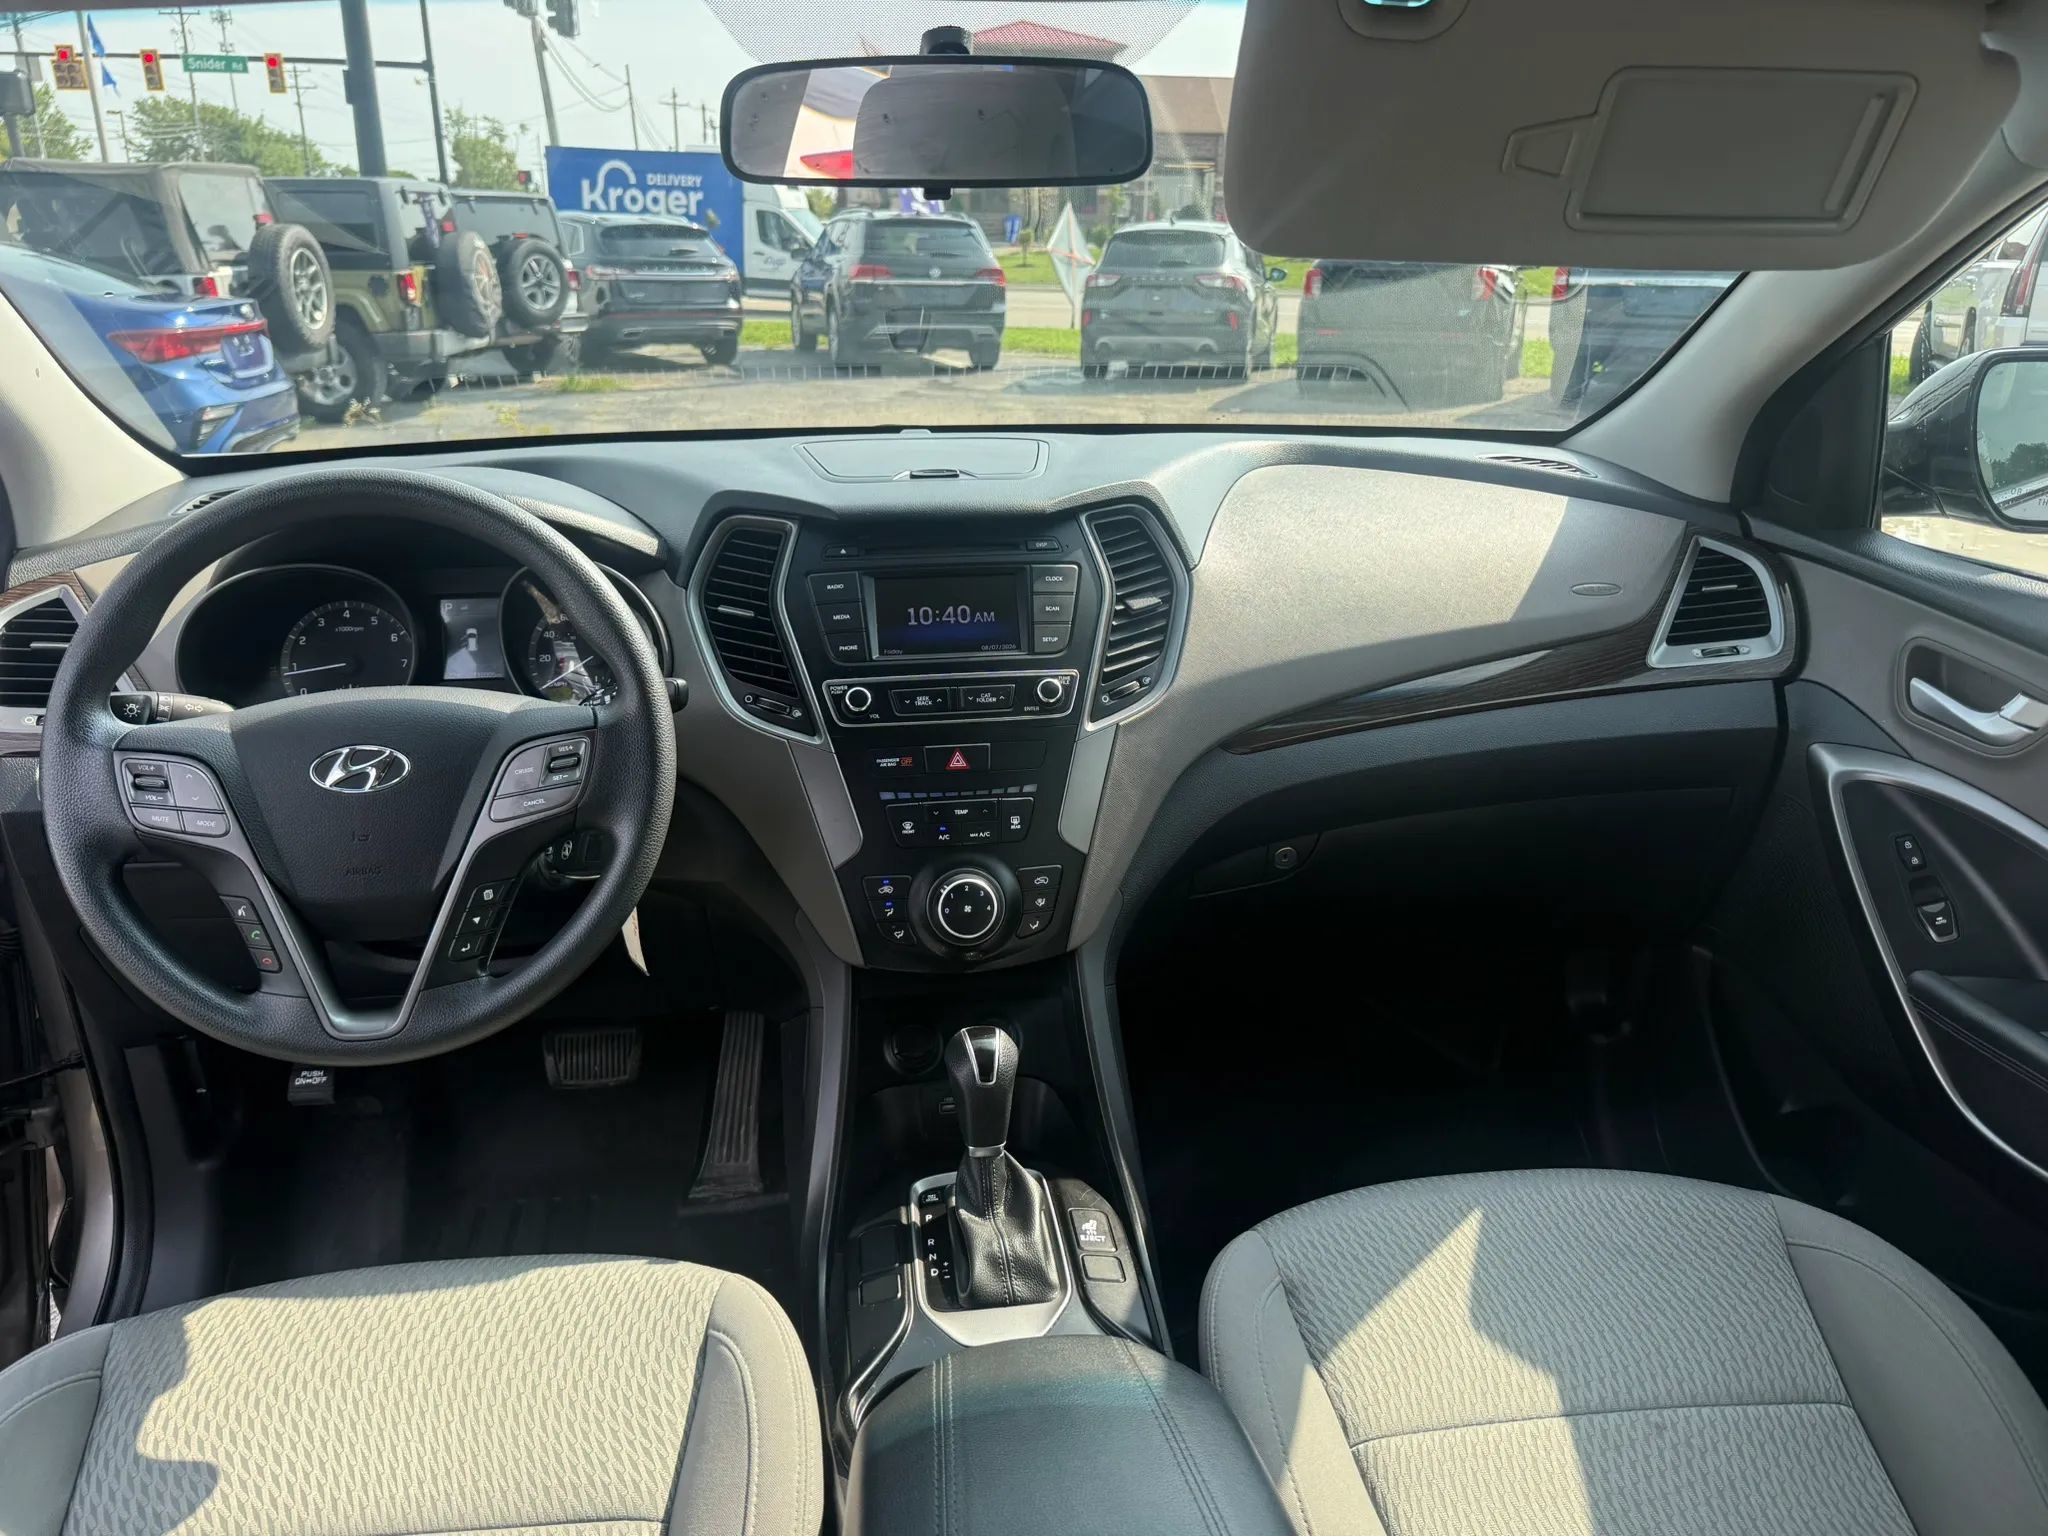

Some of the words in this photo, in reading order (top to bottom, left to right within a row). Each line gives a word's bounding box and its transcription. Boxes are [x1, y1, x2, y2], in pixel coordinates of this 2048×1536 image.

[187, 57, 226, 70] Snider
[646, 173, 703, 188] DELIVERY
[581, 160, 704, 216] Kroger
[343, 609, 350, 618] 4
[907, 604, 971, 626] 10:40
[974, 611, 995, 623] AM
[318, 618, 325, 627] 3
[371, 616, 378, 625] 5
[390, 633, 398, 642] 6
[543, 630, 555, 639] 40
[299, 636, 307, 645] 2
[539, 654, 551, 662] 20
[401, 658, 408, 668] 7
[514, 767, 534, 775] CRUISE
[523, 798, 546, 807] CANCEL
[925, 1214, 933, 1222] P
[927, 1238, 935, 1246] R
[929, 1253, 937, 1261] N
[930, 1268, 939, 1277] D
